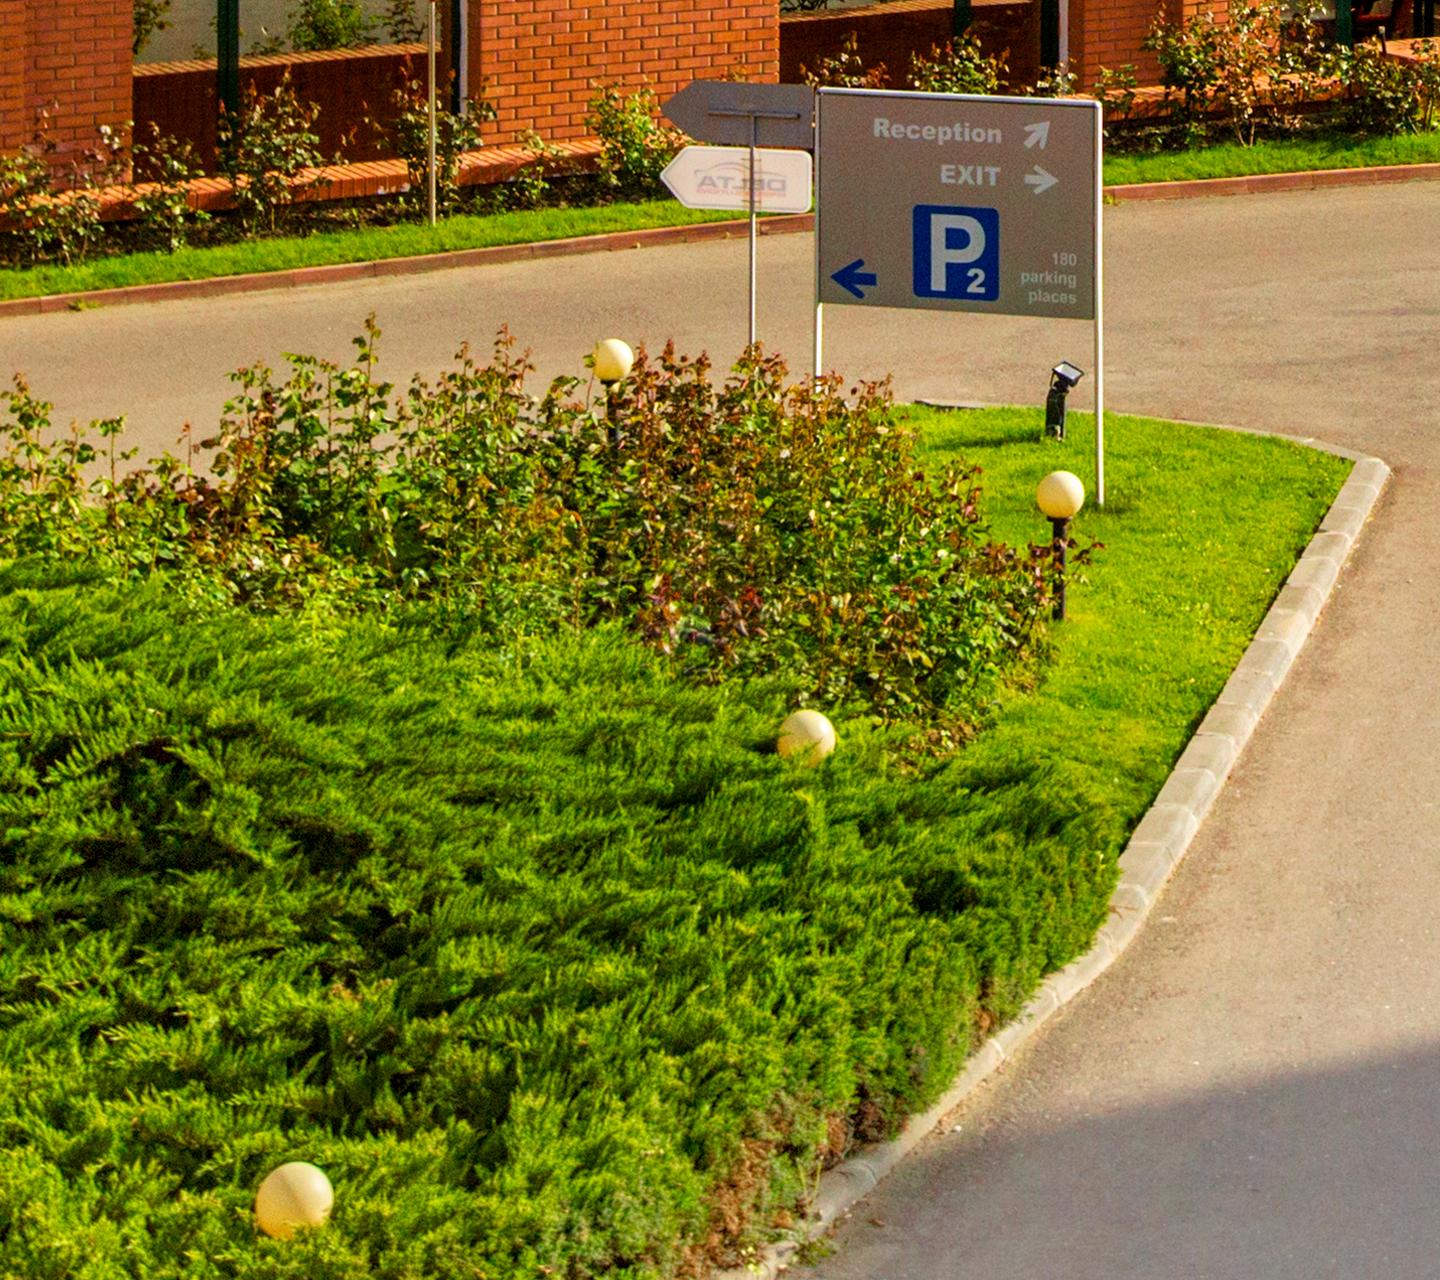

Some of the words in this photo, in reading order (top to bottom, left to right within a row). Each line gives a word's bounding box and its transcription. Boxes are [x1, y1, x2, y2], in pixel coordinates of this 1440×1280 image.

[873, 118, 1002, 146] Reception
[940, 164, 1001, 187] EXIT
[1052, 252, 1077, 266] 180
[1020, 271, 1077, 289] parking
[1028, 289, 1078, 305] places
